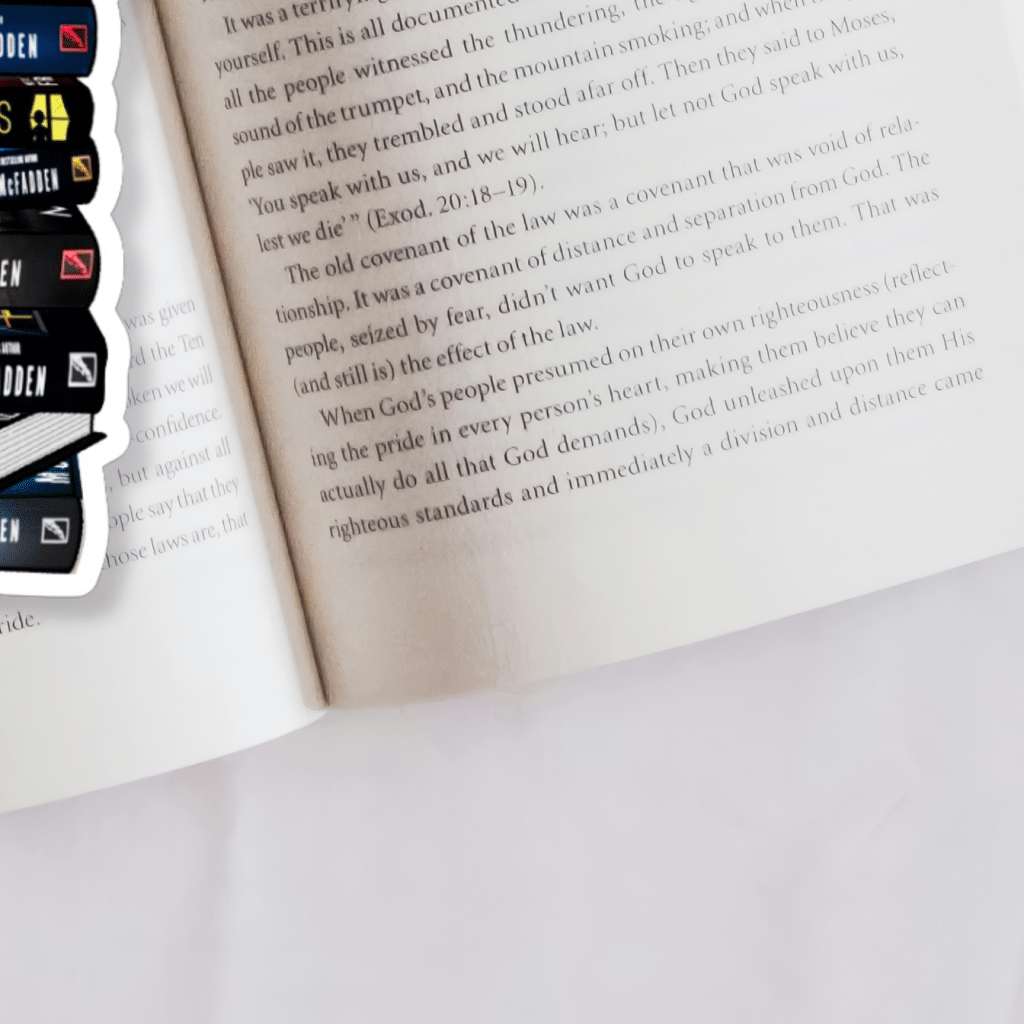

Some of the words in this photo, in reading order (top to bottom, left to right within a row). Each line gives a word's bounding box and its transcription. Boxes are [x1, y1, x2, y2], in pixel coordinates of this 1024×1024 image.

[284, 263, 320, 284] The
[325, 252, 355, 277] old
[360, 236, 450, 270] covenant
[457, 224, 476, 247] of
[484, 220, 516, 240] the
[522, 212, 556, 231] law
[564, 201, 601, 220] was
[610, 198, 619, 210] a
[626, 170, 715, 205] covenant
[722, 158, 760, 180] that
[767, 152, 802, 167] was
[808, 131, 848, 156] void
[855, 126, 872, 144] of
[880, 116, 919, 138] rela-
[123, 310, 155, 329] was
[159, 299, 196, 326] given
[293, 370, 331, 397] (and
[335, 362, 368, 388] still
[372, 359, 395, 383] is)
[400, 351, 432, 376] the
[436, 342, 491, 368] effect
[496, 331, 518, 353] of
[522, 327, 554, 349] the
[559, 317, 598, 338] law.
[118, 466, 148, 488] but
[155, 447, 211, 479] against
[216, 436, 230, 457] all
[329, 513, 410, 542] righteous
[415, 487, 513, 524] standards
[522, 475, 559, 501] and
[567, 445, 693, 490] immediately
[704, 441, 712, 456] a
[721, 421, 798, 450] division
[808, 402, 841, 428] and
[850, 384, 926, 415] distance
[935, 368, 983, 391] came
[150, 534, 188, 556] laws
[192, 526, 220, 543] are,
[222, 513, 248, 533] that
